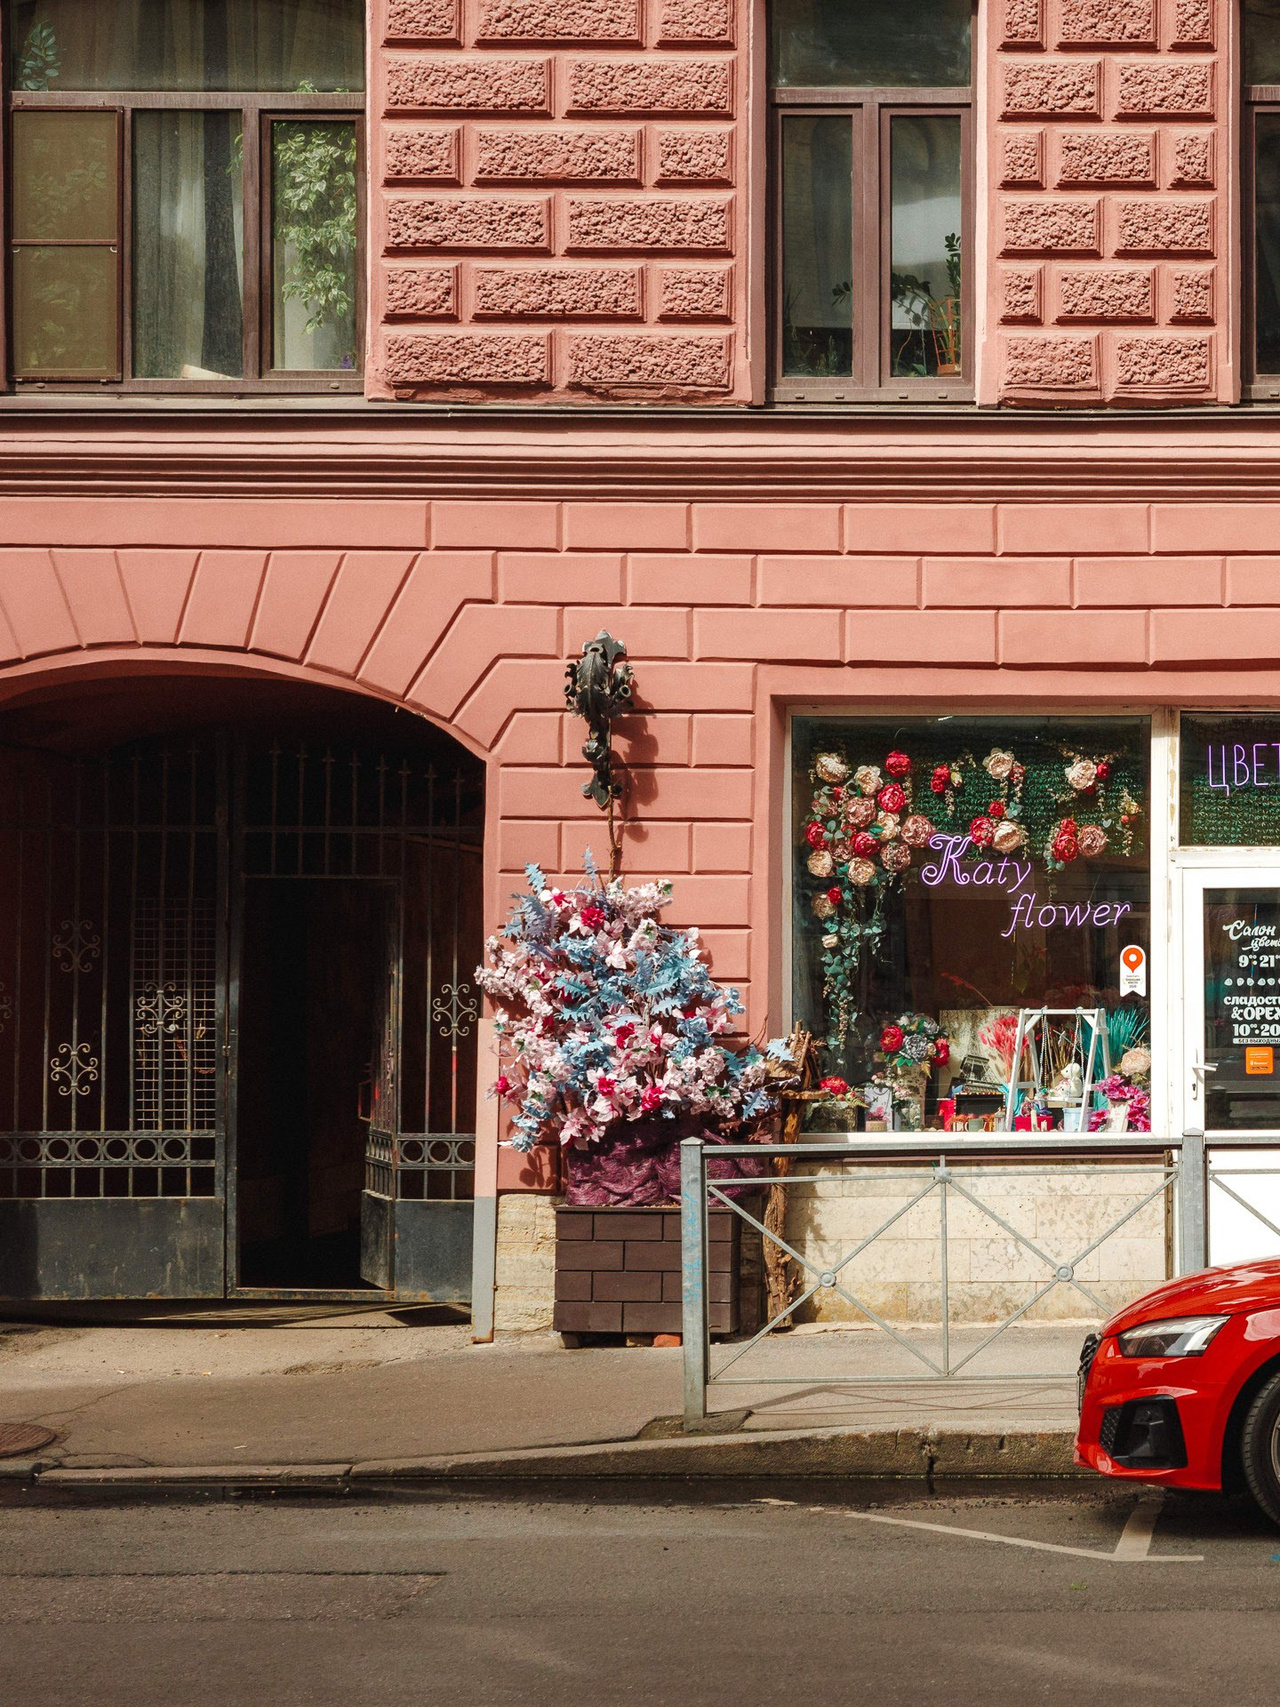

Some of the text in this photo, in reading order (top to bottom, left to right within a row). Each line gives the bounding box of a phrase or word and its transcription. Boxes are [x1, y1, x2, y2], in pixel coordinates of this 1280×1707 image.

[921, 833, 1031, 894] Katy
[1000, 892, 1131, 938] flower
[1222, 919, 1277, 940] Салон
